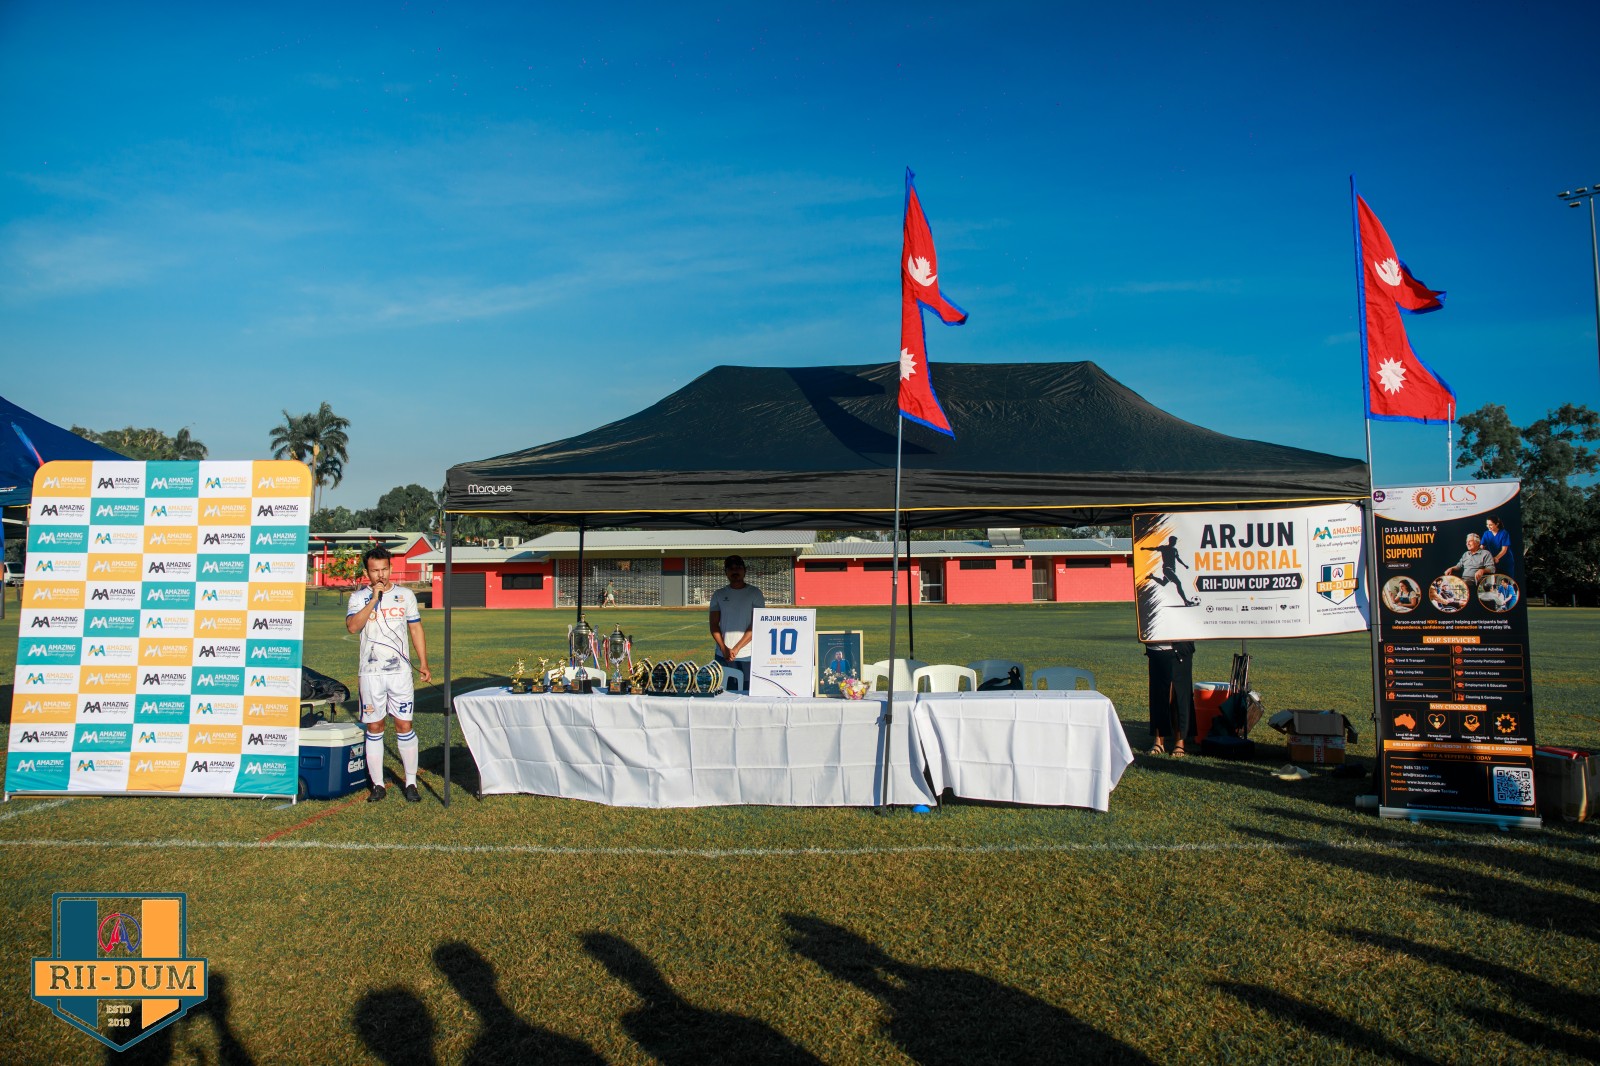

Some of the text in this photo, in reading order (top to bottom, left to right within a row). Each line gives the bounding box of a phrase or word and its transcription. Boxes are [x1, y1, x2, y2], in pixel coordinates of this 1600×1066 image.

[468, 484, 512, 495] Marquee
[1436, 485, 1477, 503] TCS
[1200, 521, 1294, 548] ARJUN
[1385, 533, 1435, 545] COMMUNITY
[1386, 547, 1422, 559] SUPPORT
[1194, 549, 1301, 571] MEMORIAL
[1202, 576, 1297, 590] RII-DUM CUP 2026
[1320, 580, 1356, 591] RII-DUM
[381, 607, 405, 617] TCS
[769, 628, 798, 655] 10
[399, 702, 413, 714] 27
[37, 759, 64, 767] AMAZING
